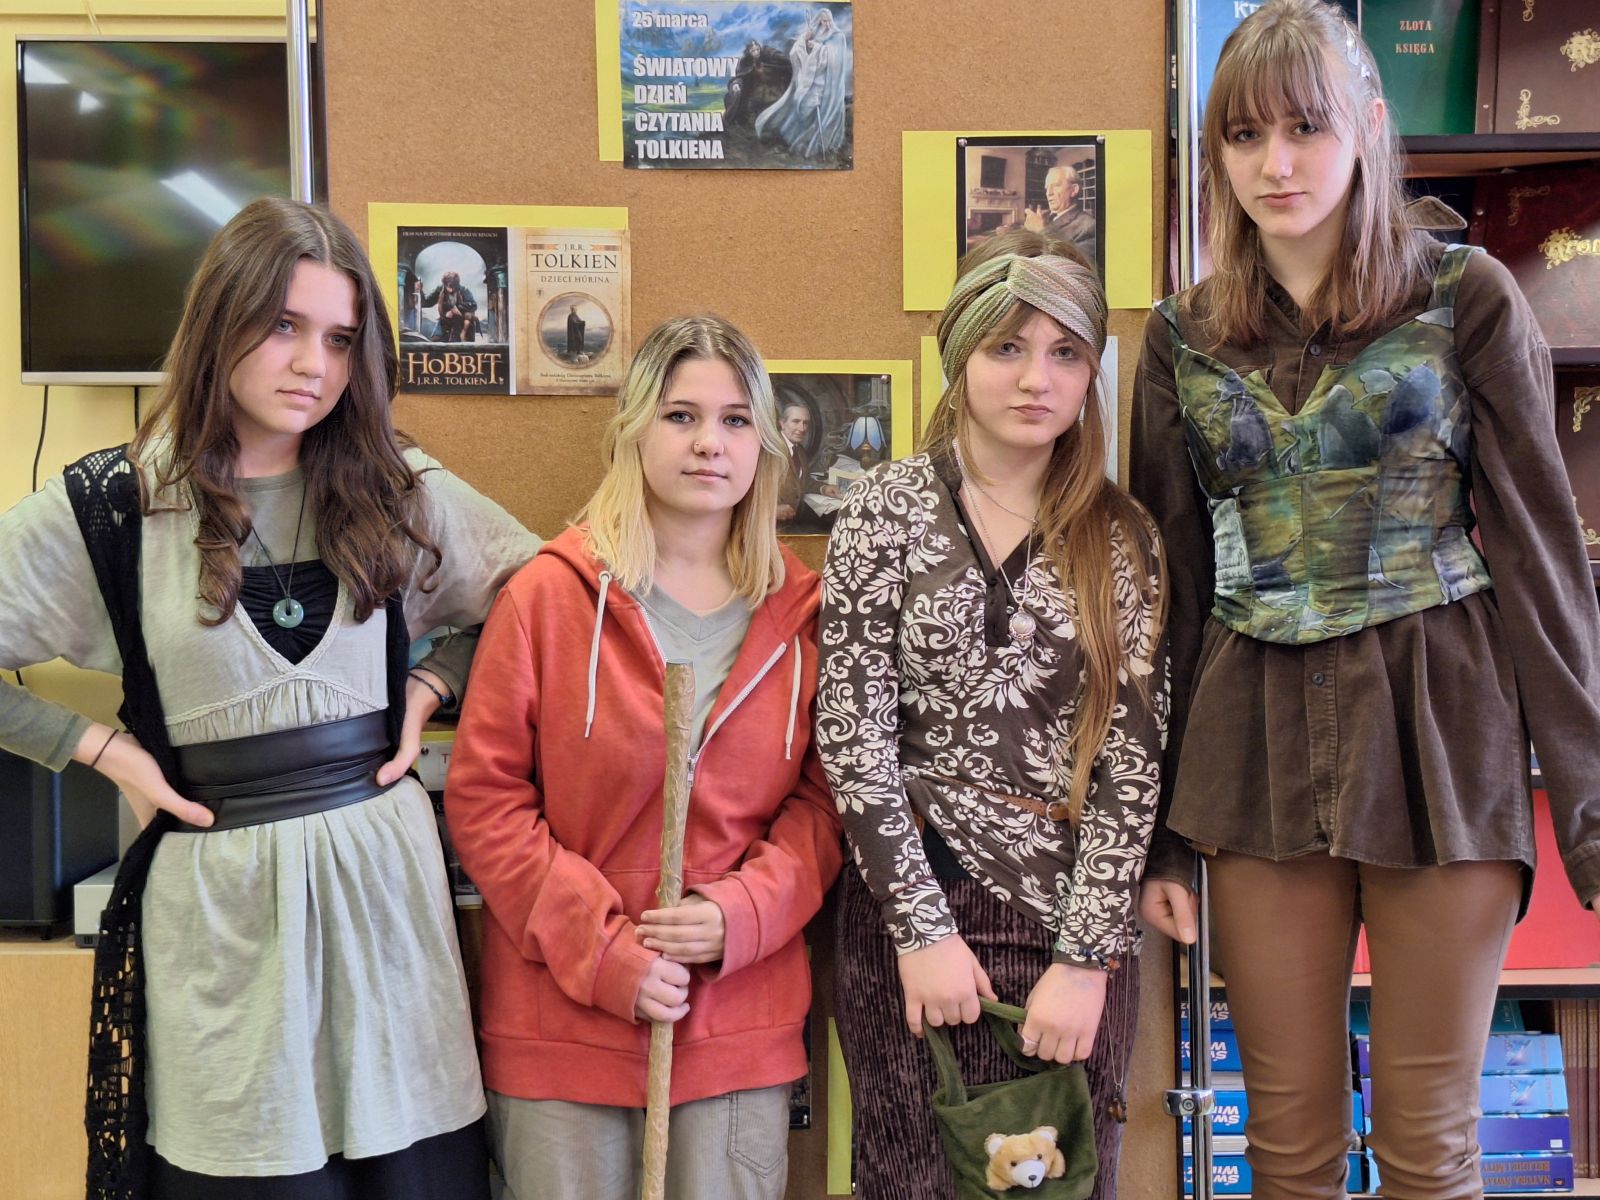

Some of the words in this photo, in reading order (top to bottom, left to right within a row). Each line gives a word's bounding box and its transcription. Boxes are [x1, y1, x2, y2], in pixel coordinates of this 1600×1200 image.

[632, 11, 653, 28] 25
[655, 13, 708, 28] marca
[1395, 43, 1435, 56] KSIĘGA
[633, 54, 740, 77] ŚWIATOWY
[634, 82, 687, 105] DZIEŃ
[635, 112, 724, 132] CZYTANIA
[635, 140, 725, 159] TOLKIENA
[564, 244, 585, 252] J.R.R.
[531, 253, 617, 269] TOLKIEN
[540, 275, 572, 283] DZIECI
[417, 376, 443, 386] J.R.R.
[445, 376, 488, 385] TOLKIEN
